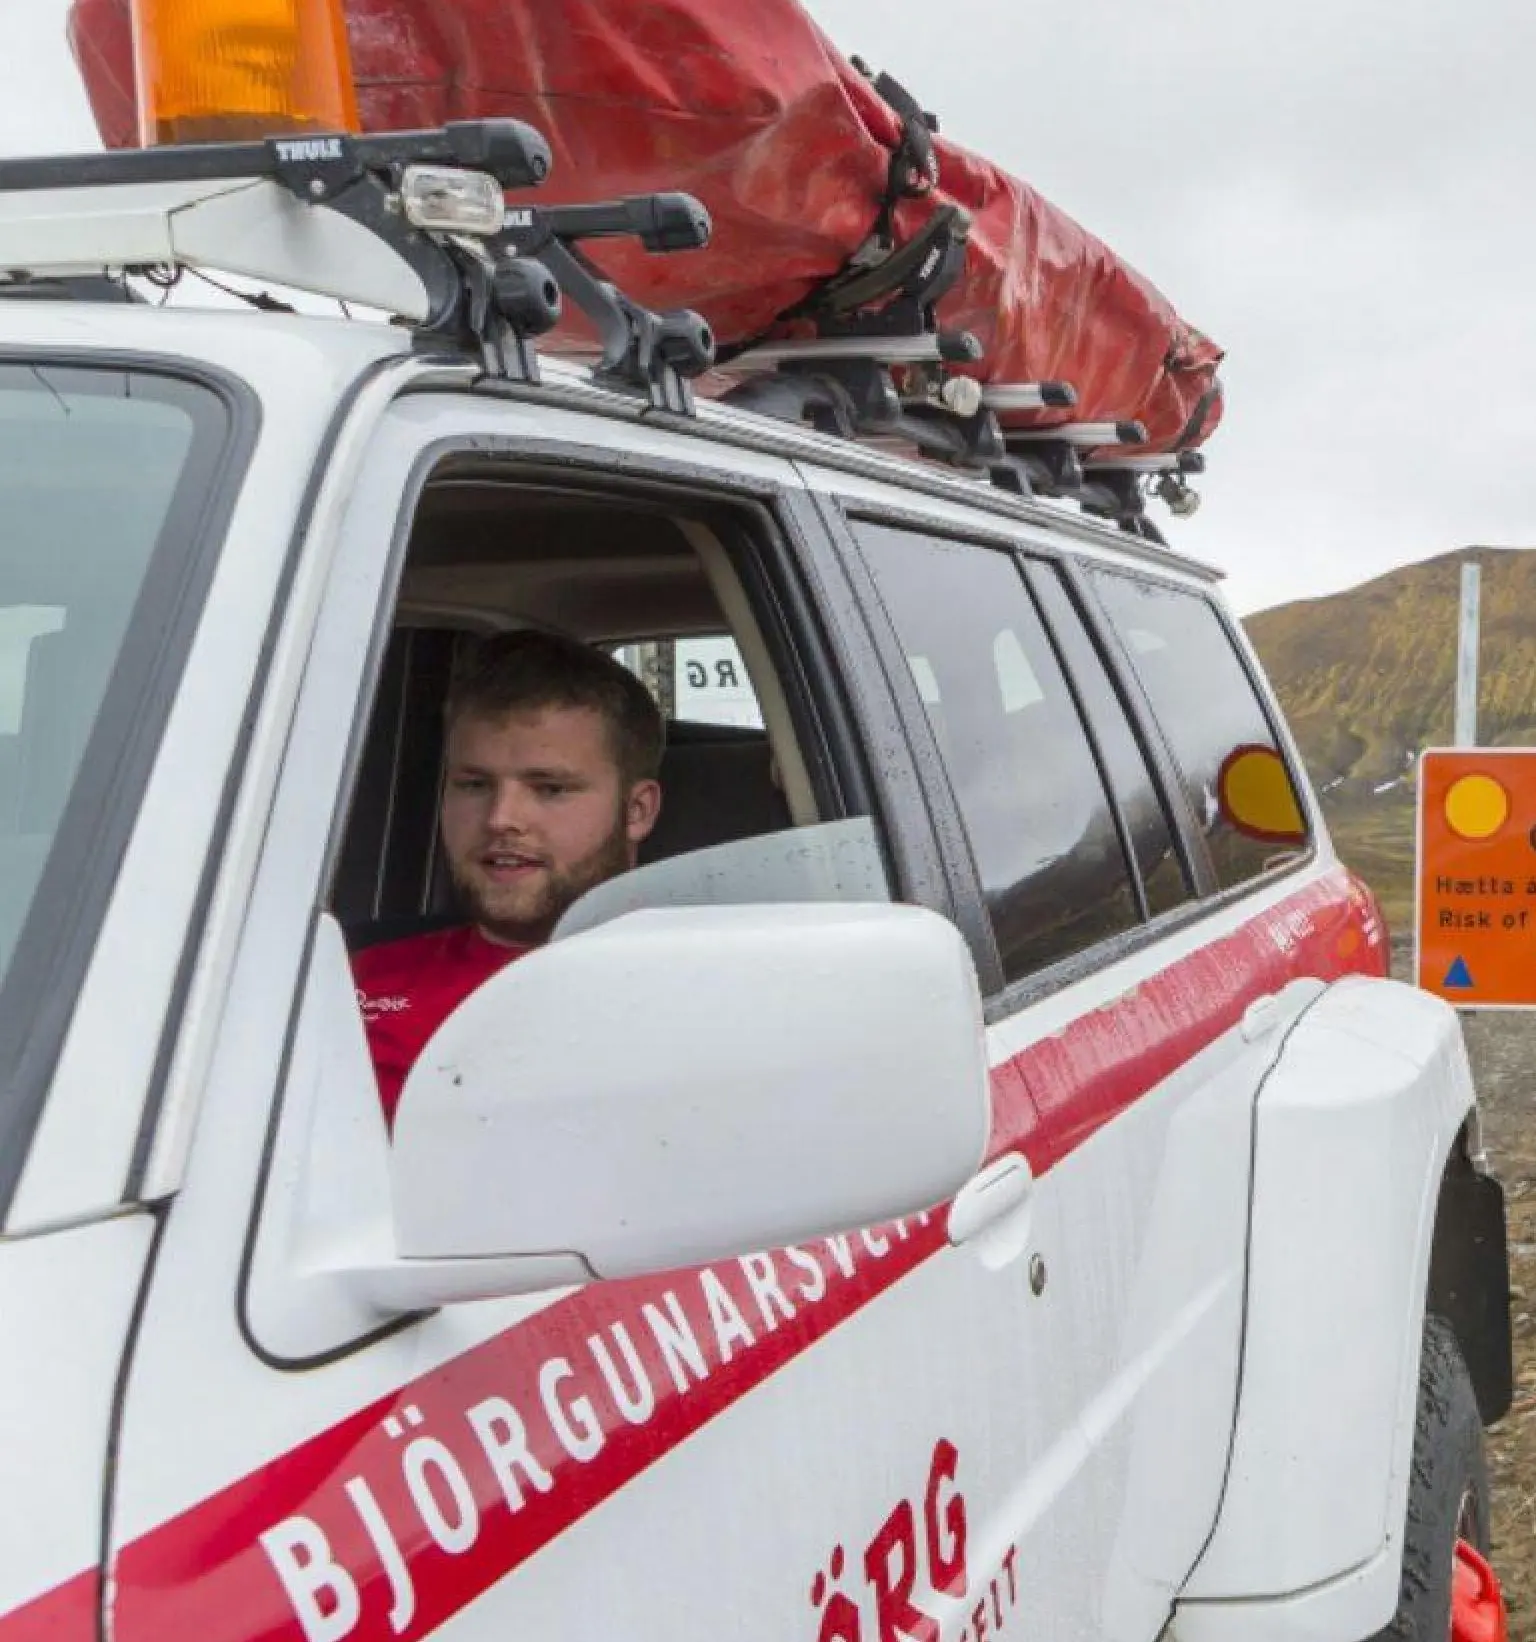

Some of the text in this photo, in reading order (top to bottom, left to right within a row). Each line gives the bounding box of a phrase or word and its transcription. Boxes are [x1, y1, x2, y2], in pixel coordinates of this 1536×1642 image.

[275, 139, 343, 161] THULE
[1436, 876, 1514, 895] Hætta
[1439, 910, 1491, 928] Risk
[1502, 910, 1528, 929] of
